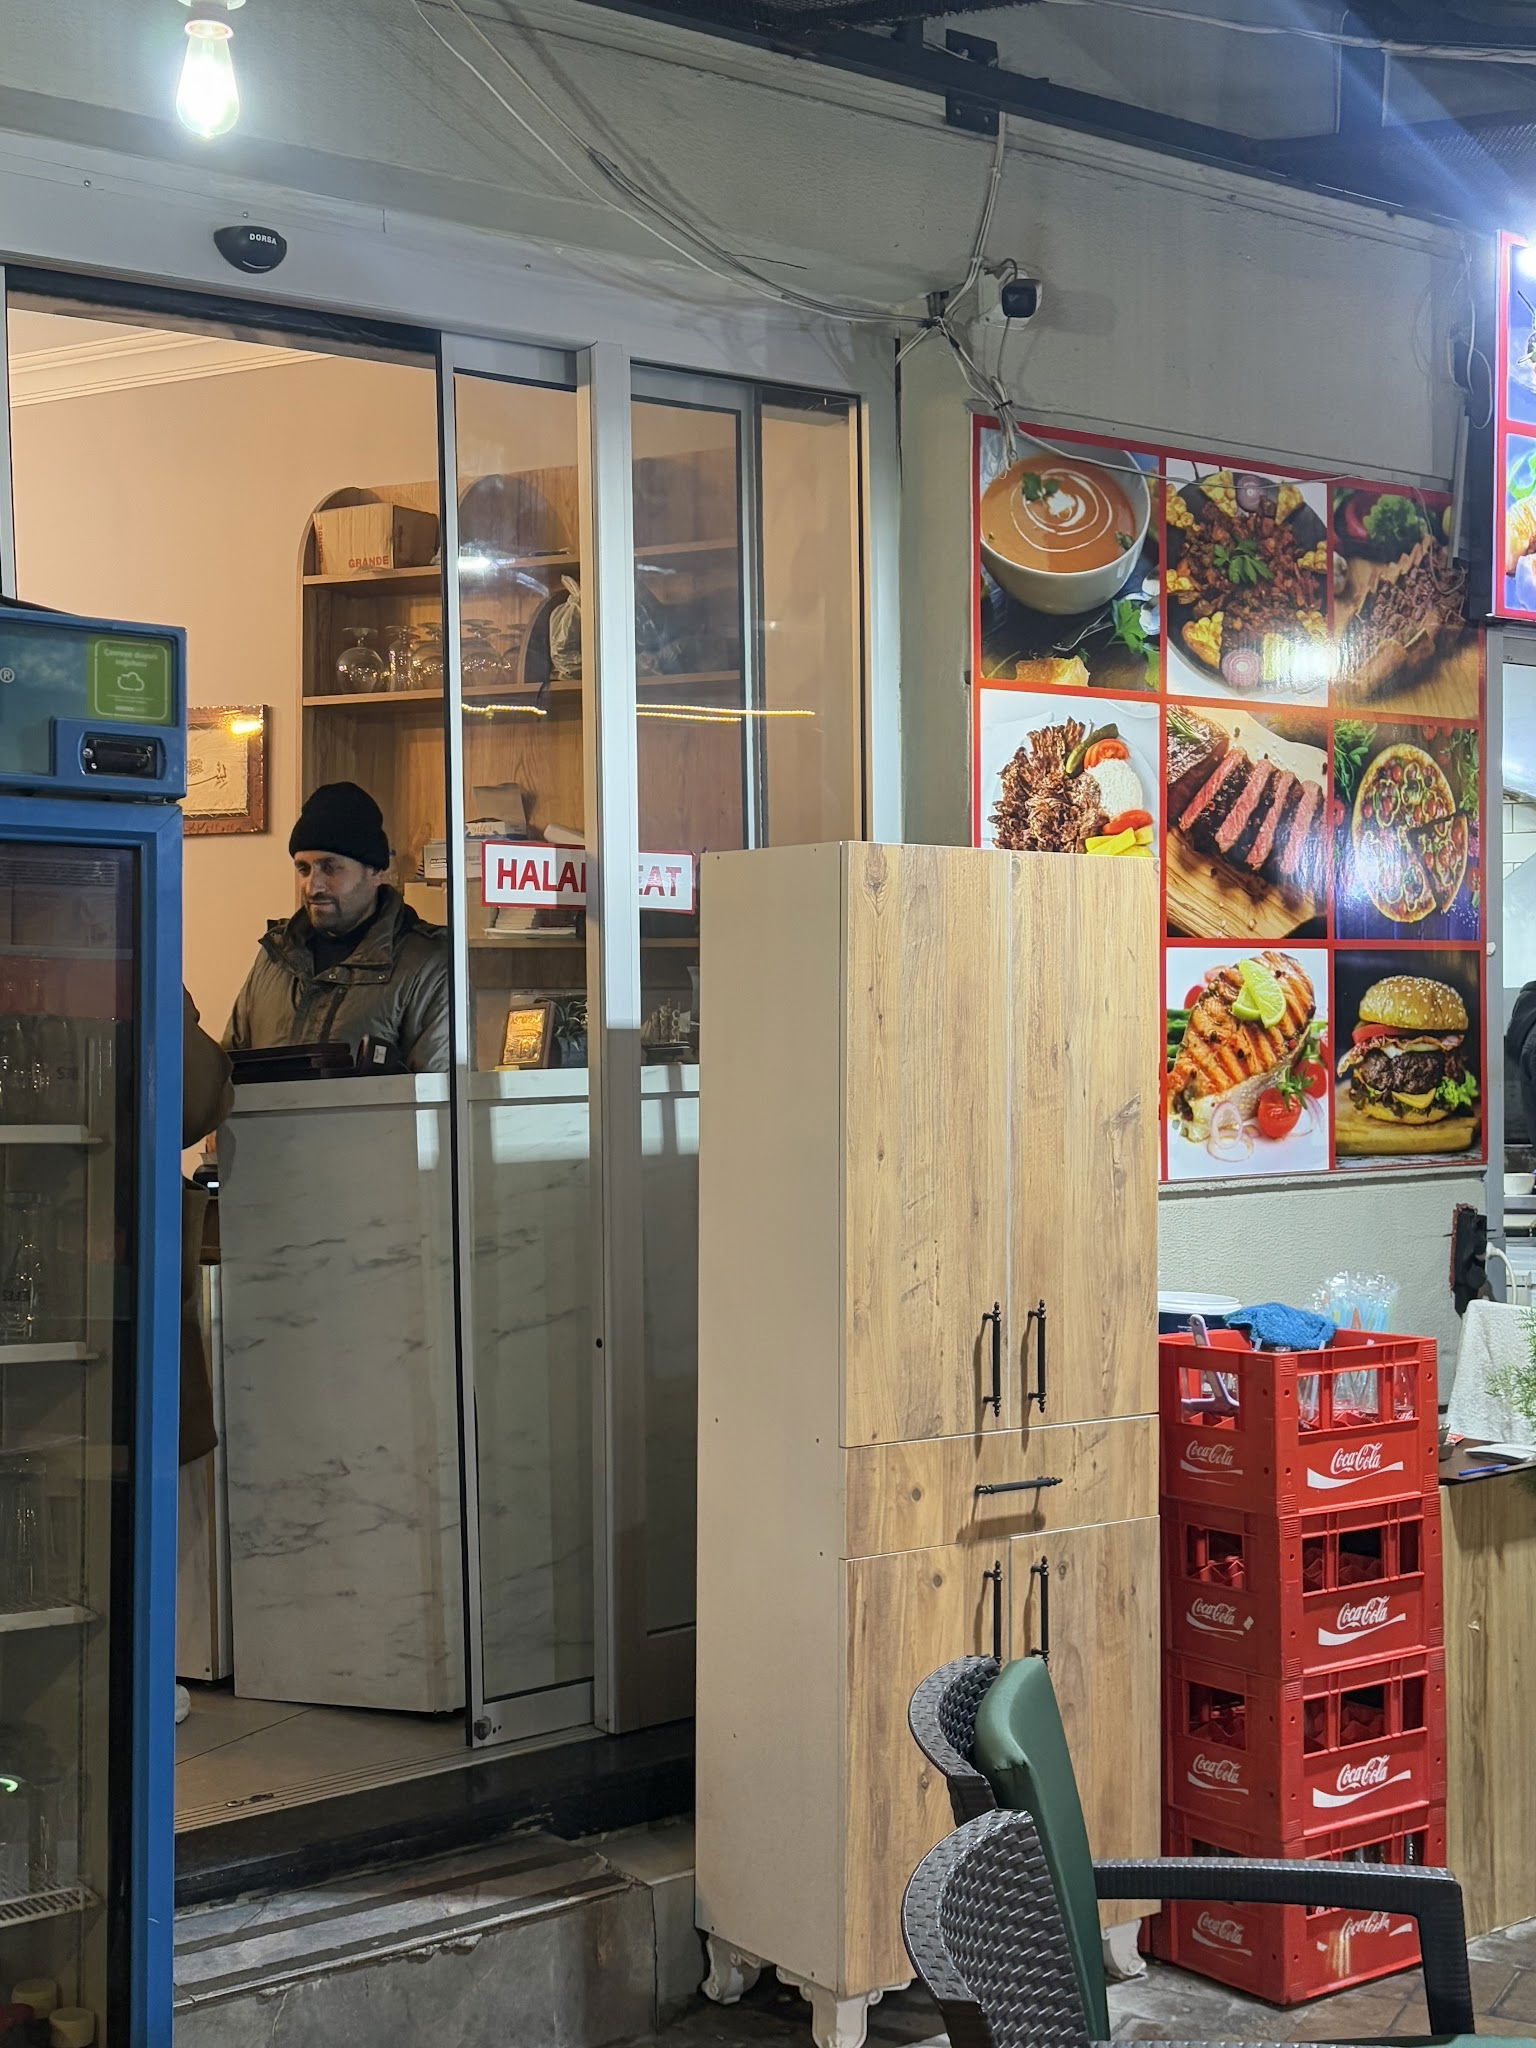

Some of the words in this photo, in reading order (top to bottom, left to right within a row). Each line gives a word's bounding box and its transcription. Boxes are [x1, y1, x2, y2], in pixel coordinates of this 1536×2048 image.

[249, 233, 277, 245] DORSA
[348, 555, 389, 568] GRANDE
[1186, 1440, 1235, 1466] Coca-Cola
[1330, 1442, 1383, 1475] Coca-Cola
[1191, 1598, 1237, 1626] Coca-Cola
[1336, 1595, 1391, 1631] Coca-Cola
[1192, 1753, 1241, 1784] Coca-Cola
[1336, 1754, 1391, 1792] Coca-Cola
[1197, 1911, 1244, 1945] Coca-Cola
